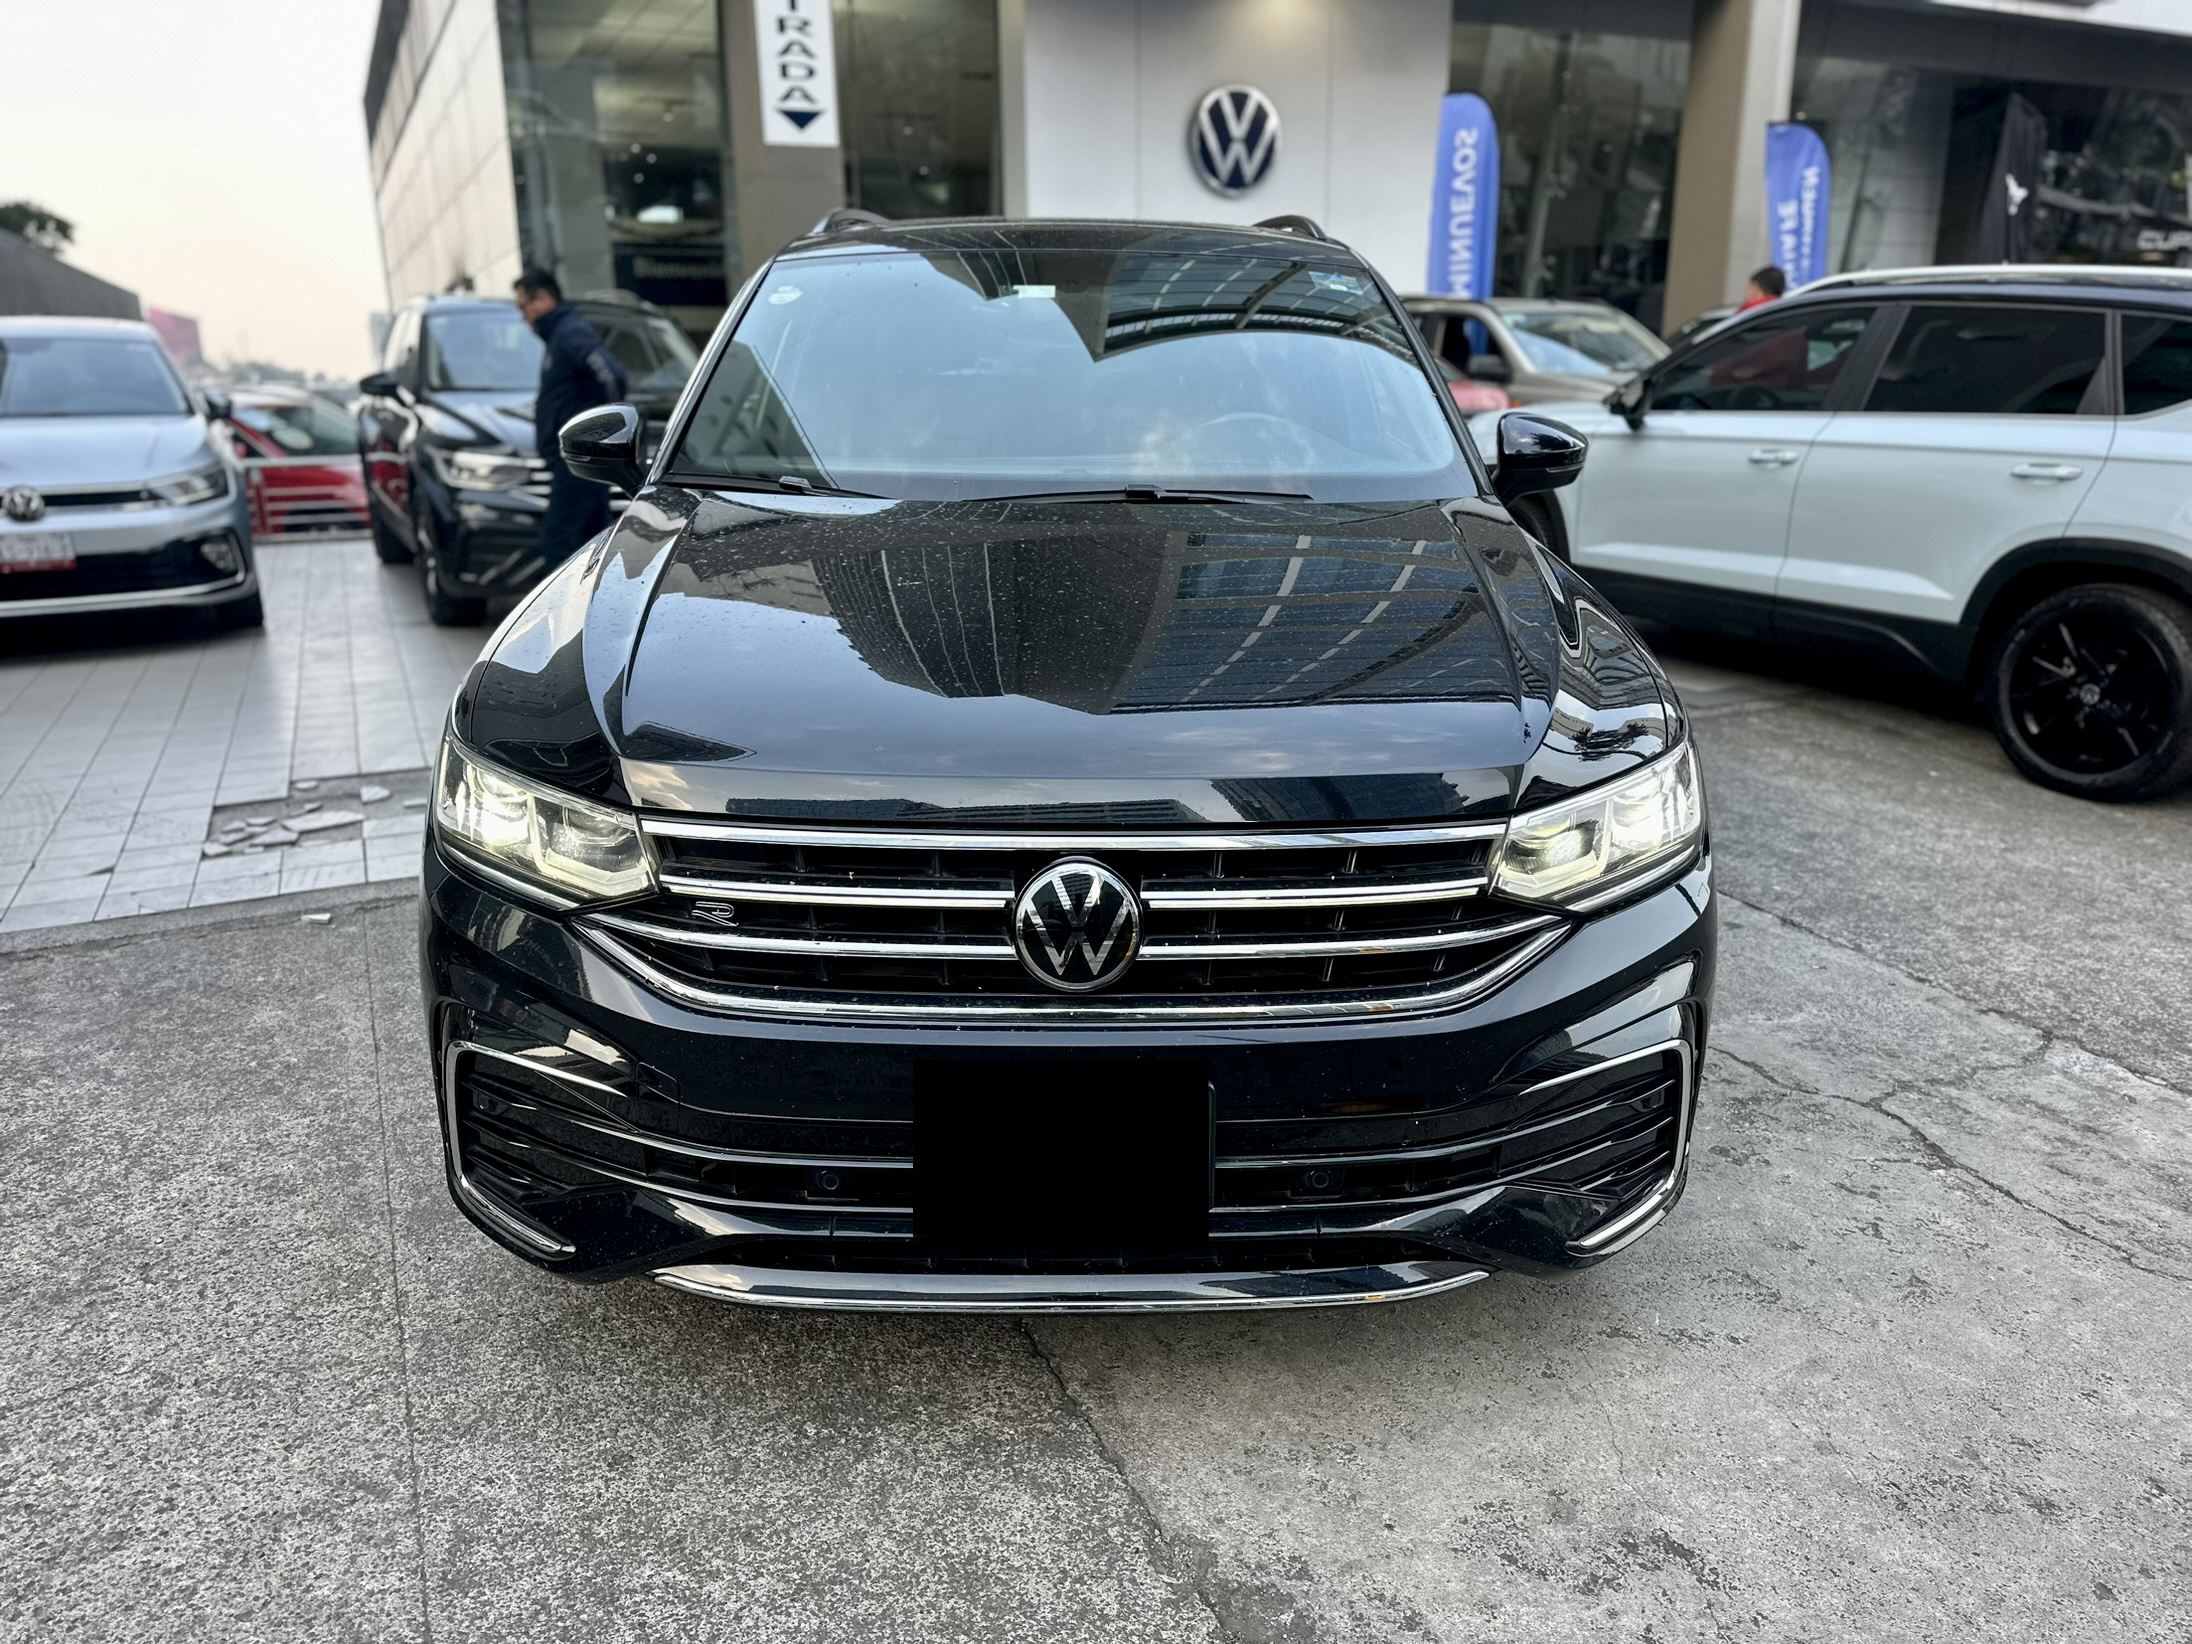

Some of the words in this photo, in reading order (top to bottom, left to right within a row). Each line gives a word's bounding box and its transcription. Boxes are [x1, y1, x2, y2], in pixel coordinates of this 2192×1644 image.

[1197, 86, 1281, 192] VW
[691, 900, 739, 927] R
[1018, 865, 1138, 984] VW
